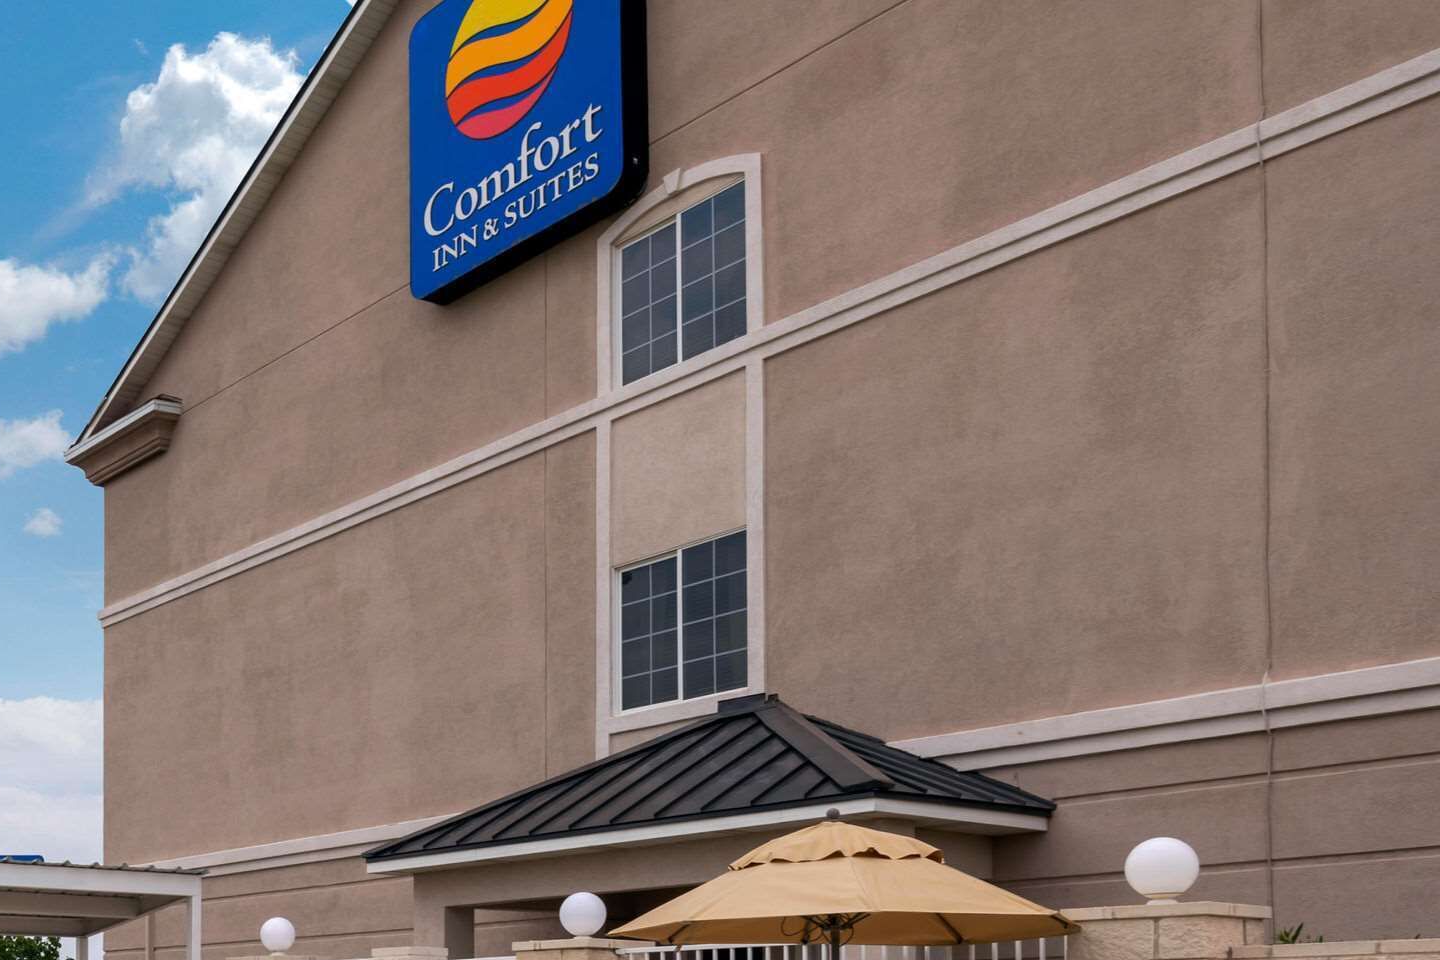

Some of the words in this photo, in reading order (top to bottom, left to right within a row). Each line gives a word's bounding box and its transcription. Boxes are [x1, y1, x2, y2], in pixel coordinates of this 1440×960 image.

[423, 103, 602, 236] Comfort
[432, 226, 477, 272] INN
[483, 217, 499, 241] &
[504, 153, 599, 228] SUITES
